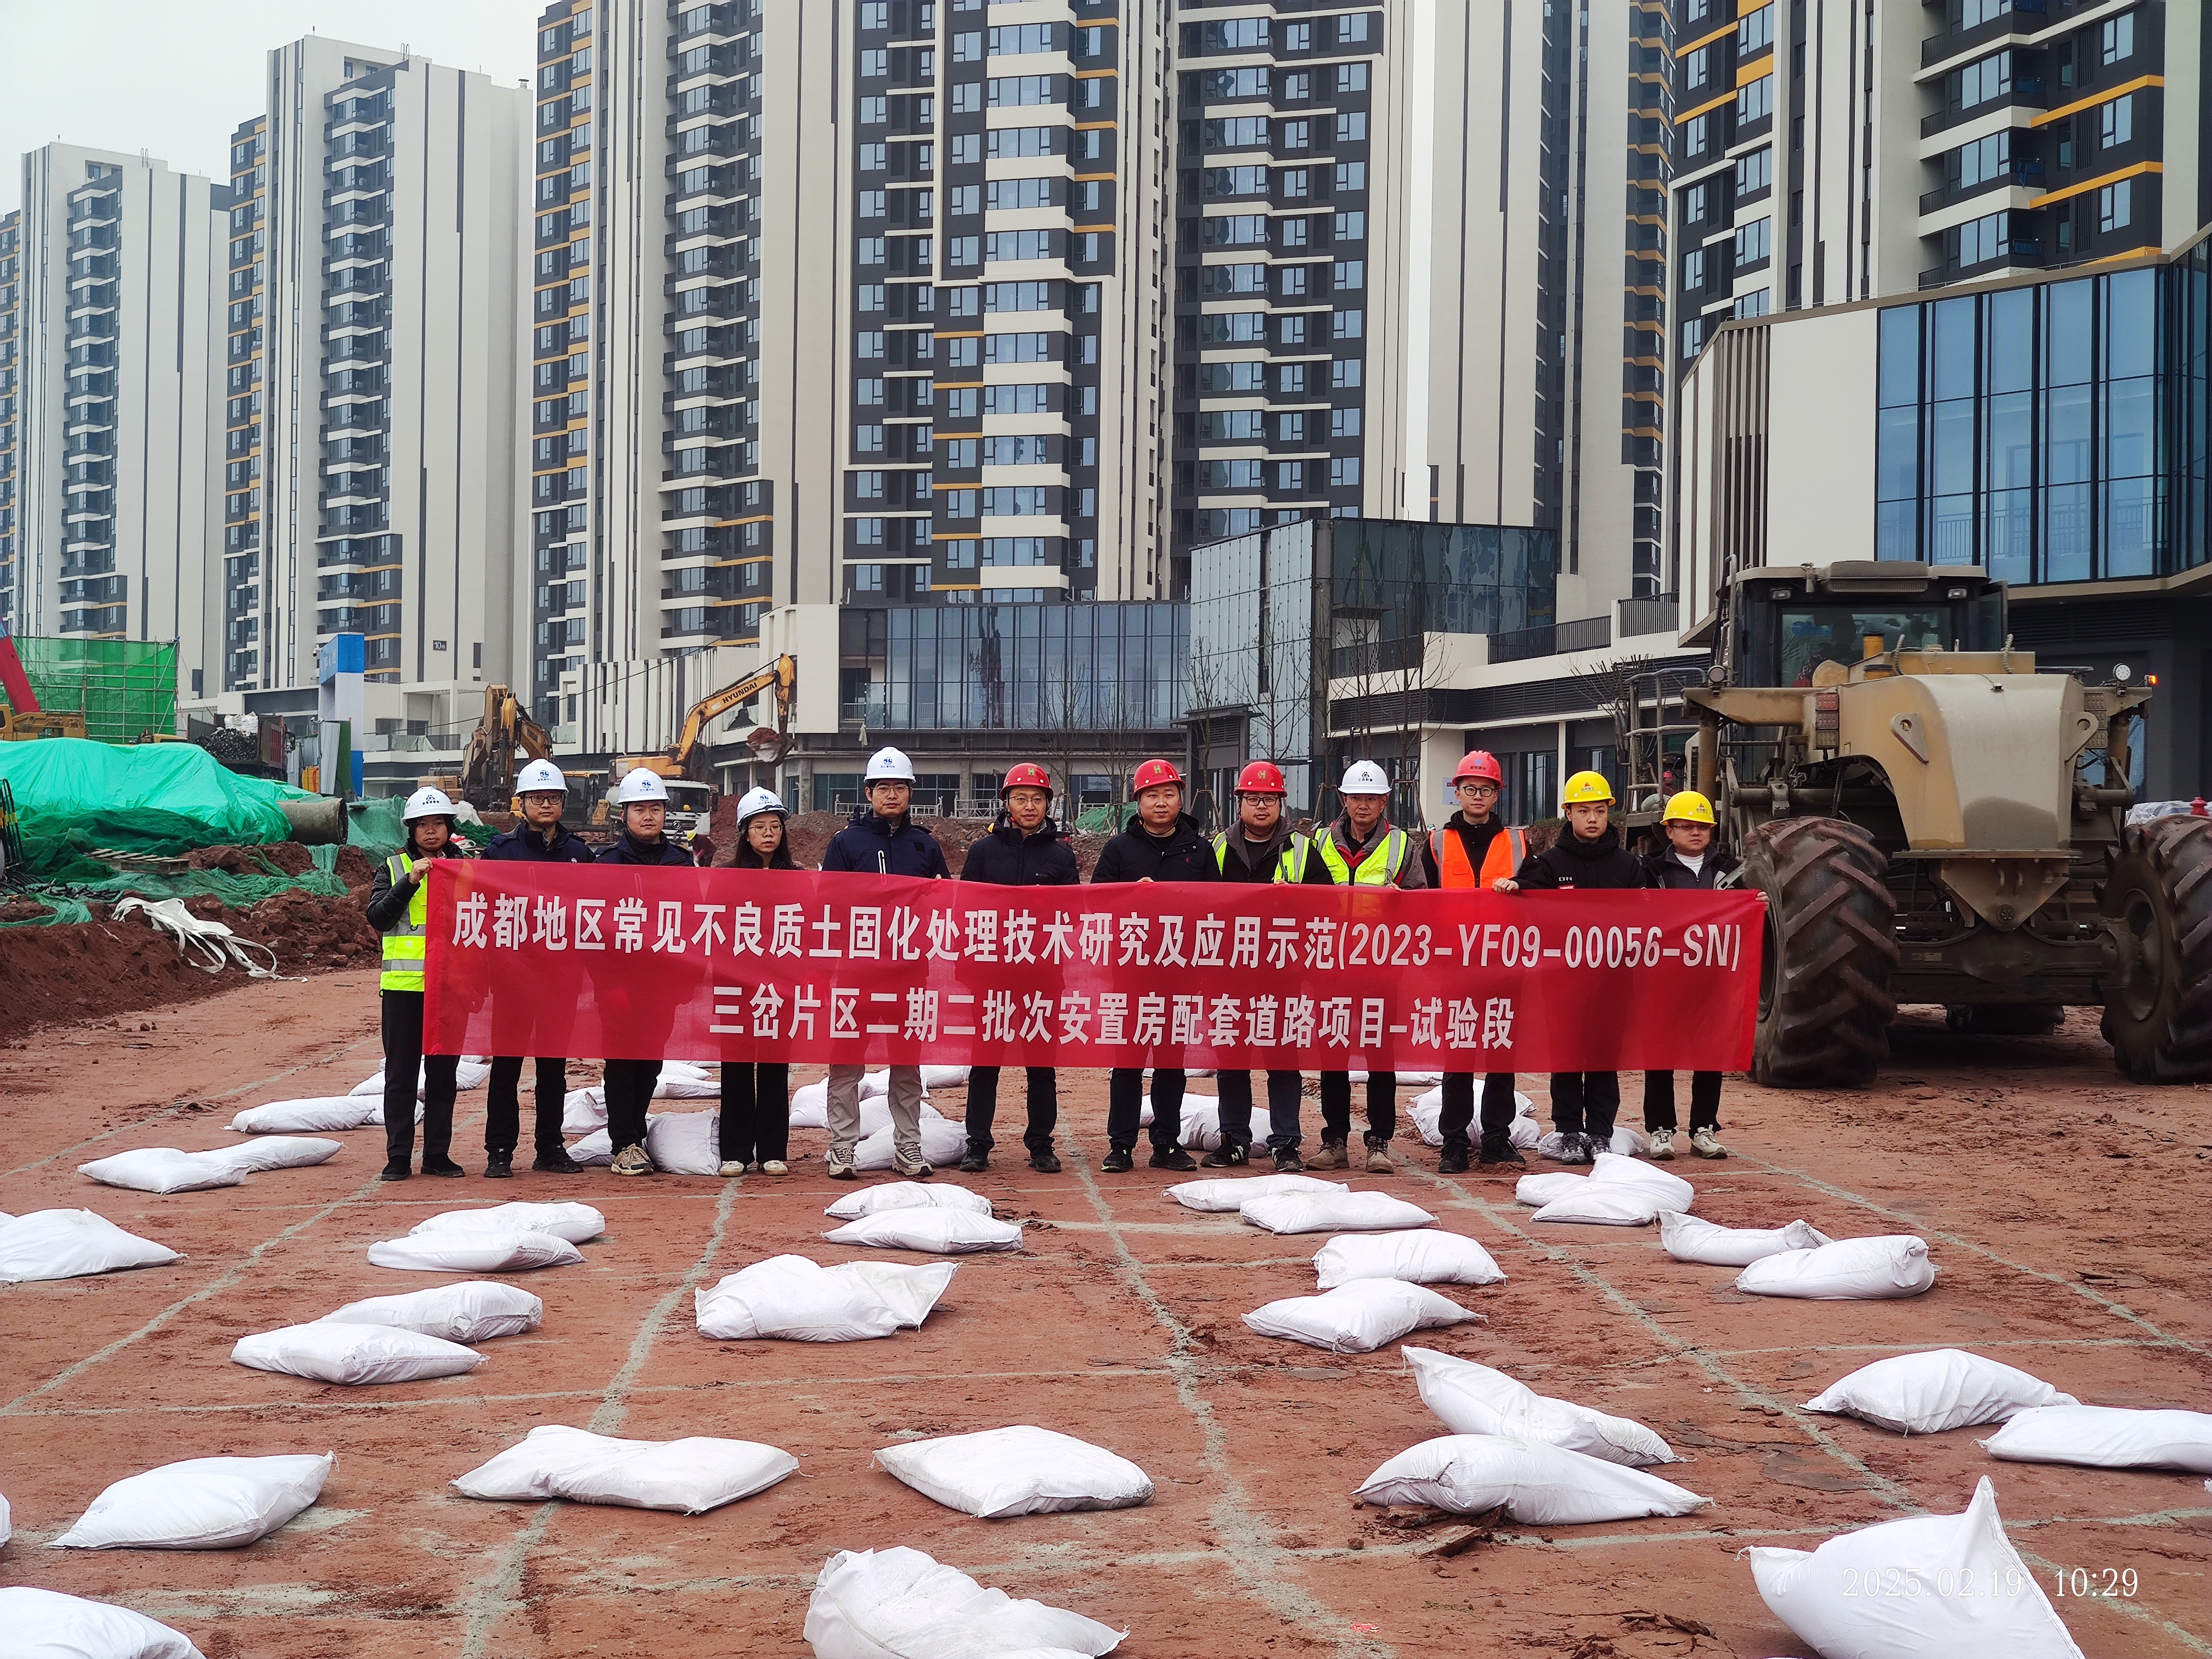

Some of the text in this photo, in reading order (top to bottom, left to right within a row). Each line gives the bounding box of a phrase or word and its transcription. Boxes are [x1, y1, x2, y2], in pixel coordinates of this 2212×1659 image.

[722, 682, 758, 704] HYUNDAI
[709, 983, 1514, 1049] 三岔片区二期二批次安置房配套道路项目-试验段
